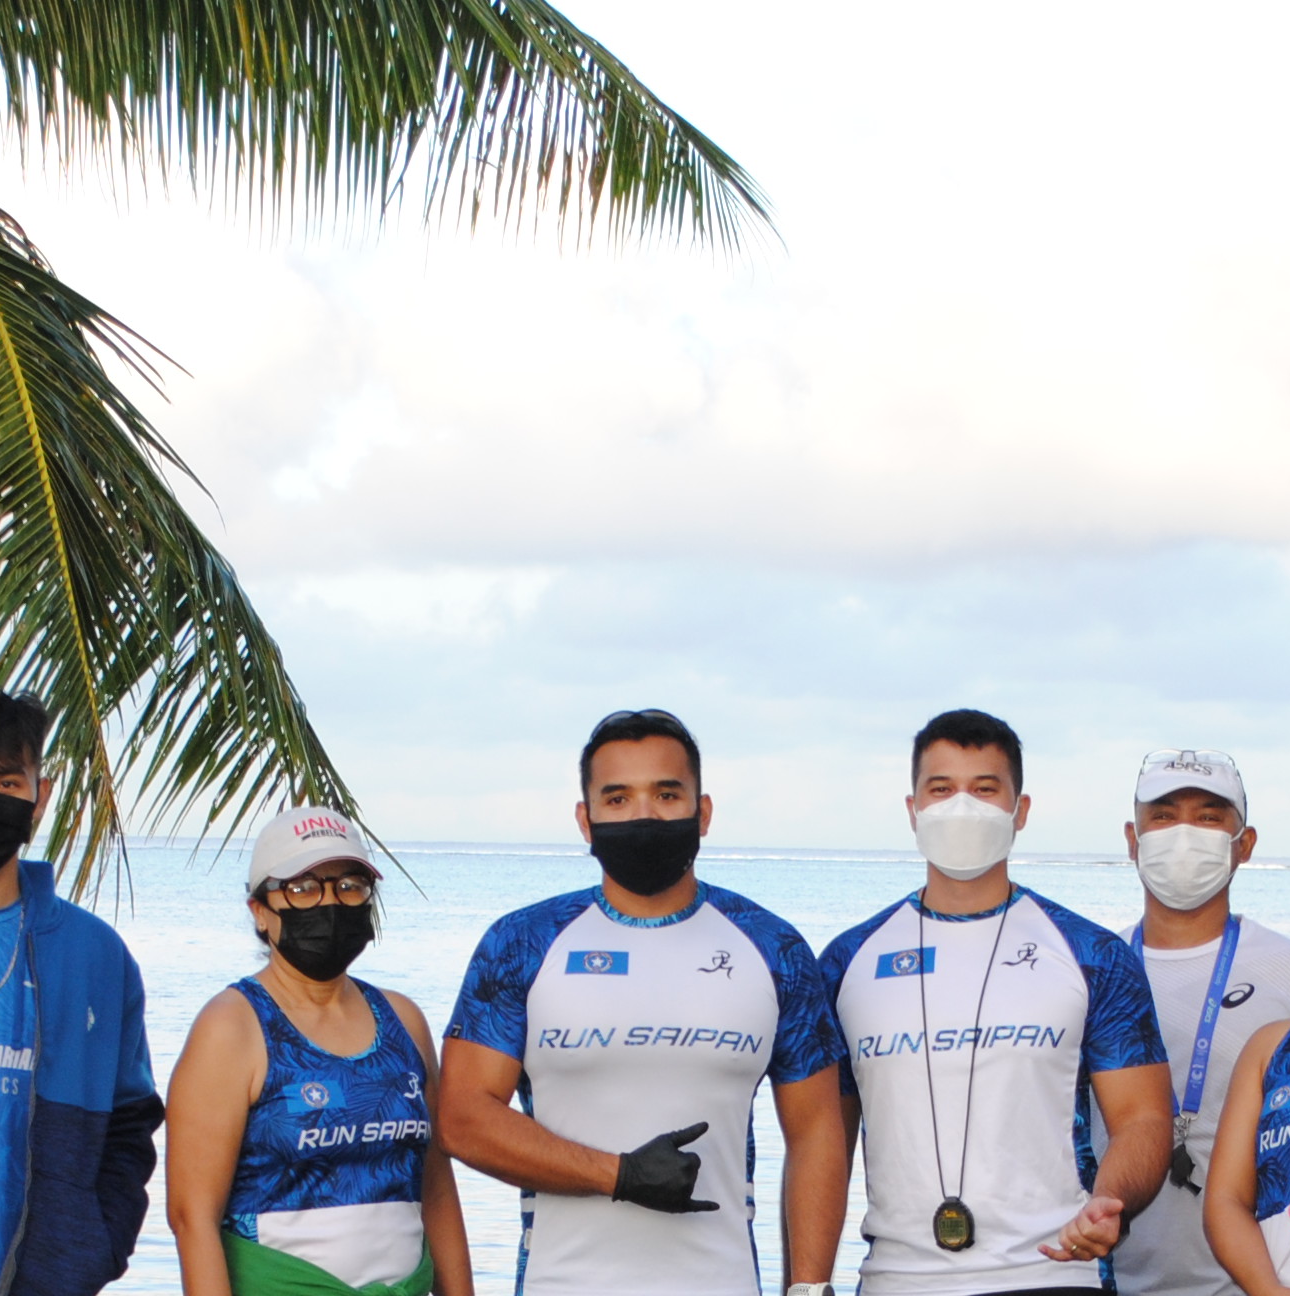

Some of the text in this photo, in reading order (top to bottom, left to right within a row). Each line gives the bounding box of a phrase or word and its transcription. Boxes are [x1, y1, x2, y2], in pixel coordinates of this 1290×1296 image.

[293, 817, 346, 836] UNLV
[538, 1026, 764, 1054] RUN SAIPAN
[857, 1024, 1067, 1061] RUN SAIPAN
[297, 1125, 357, 1150] RUN
